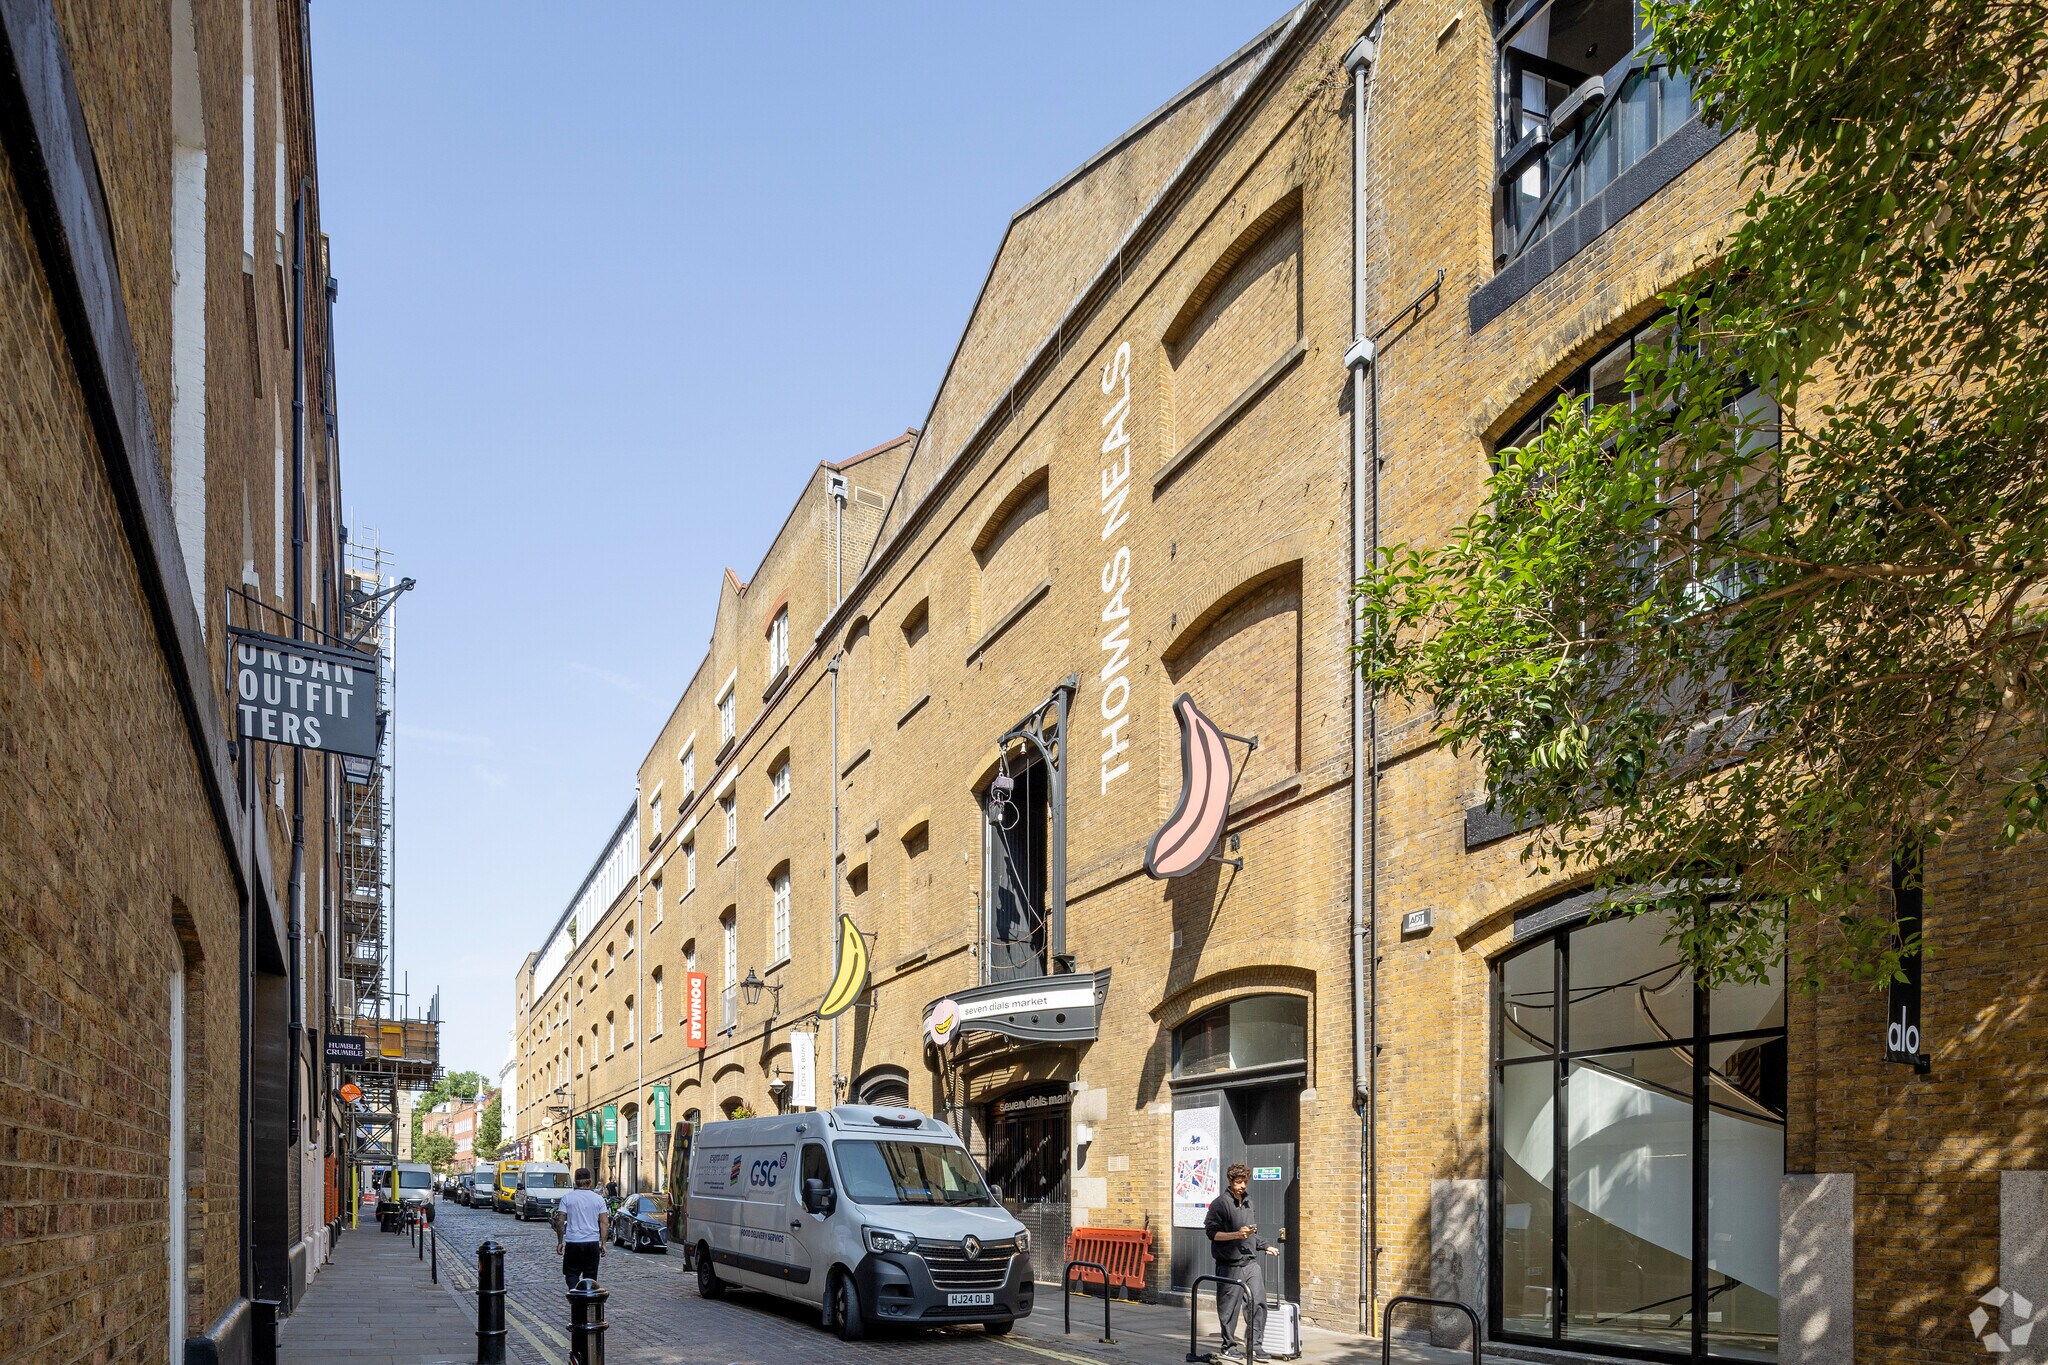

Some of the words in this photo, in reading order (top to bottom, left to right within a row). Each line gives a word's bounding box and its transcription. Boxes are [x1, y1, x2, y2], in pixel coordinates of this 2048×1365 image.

[1101, 341, 1131, 542] NEALS
[238, 646, 354, 685] URBAN
[1101, 545, 1131, 795] THOMAS
[238, 669, 354, 719] OUTFIT
[238, 704, 322, 748] TERS
[691, 978, 702, 1040] DONMAR
[964, 1006, 988, 1016] seven
[989, 1001, 1010, 1012] dials
[1011, 997, 1048, 1008] market
[328, 1042, 361, 1050] HUMBLE
[1888, 1005, 1920, 1055] alo
[326, 1049, 364, 1057] CRUMBLE
[1000, 1099, 1025, 1112] seven
[1026, 1095, 1048, 1108] dials
[750, 1160, 779, 1188] GSG
[768, 1233, 784, 1244] SERVICE
[952, 1294, 974, 1305] HJ24
